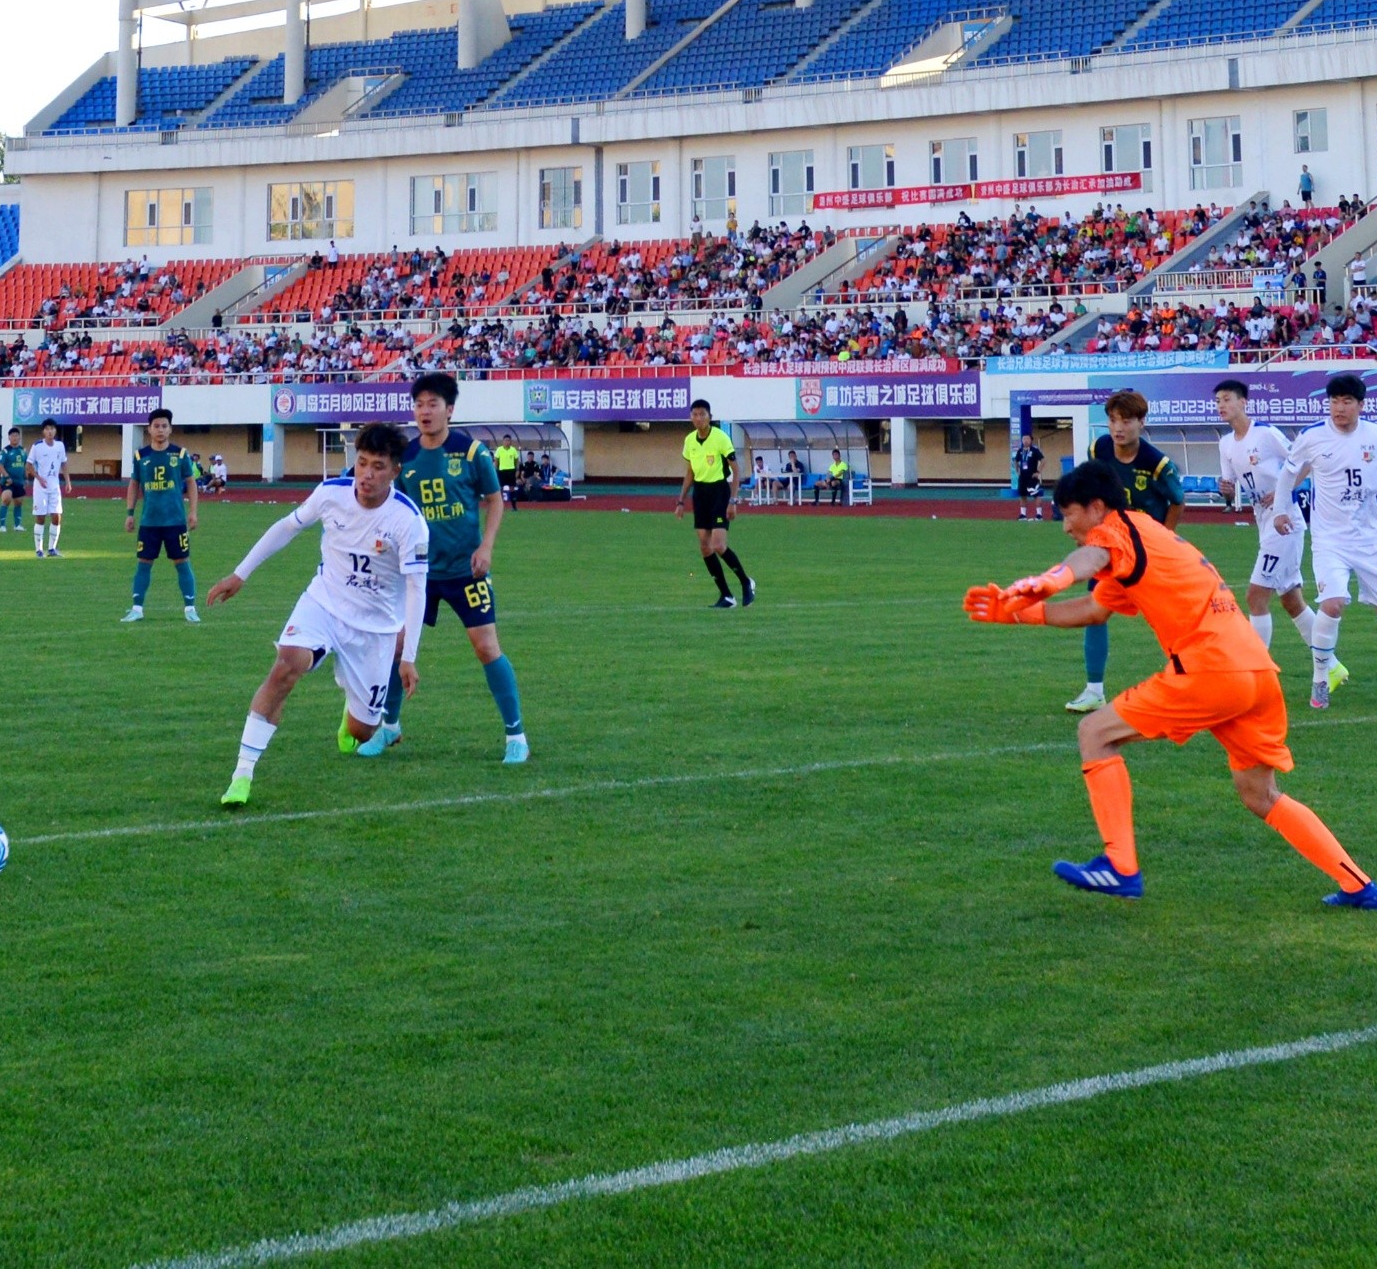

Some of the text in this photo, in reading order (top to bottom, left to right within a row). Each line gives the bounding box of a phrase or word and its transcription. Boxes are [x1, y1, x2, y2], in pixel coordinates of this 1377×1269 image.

[38, 396, 160, 415] 长治市汇承体育俱乐部
[551, 388, 687, 410] 西安荣海足球俱乐部
[826, 383, 977, 407] 廊坊荣耀之城足球俱乐部
[154, 466, 165, 480] 12
[1243, 472, 1255, 489] 17
[1345, 468, 1362, 487] 15
[420, 478, 446, 504] 69
[421, 501, 464, 522] 治汇承
[349, 552, 372, 573] 12
[1263, 554, 1279, 573] 17
[465, 582, 492, 608] 69
[369, 685, 386, 708] 12
